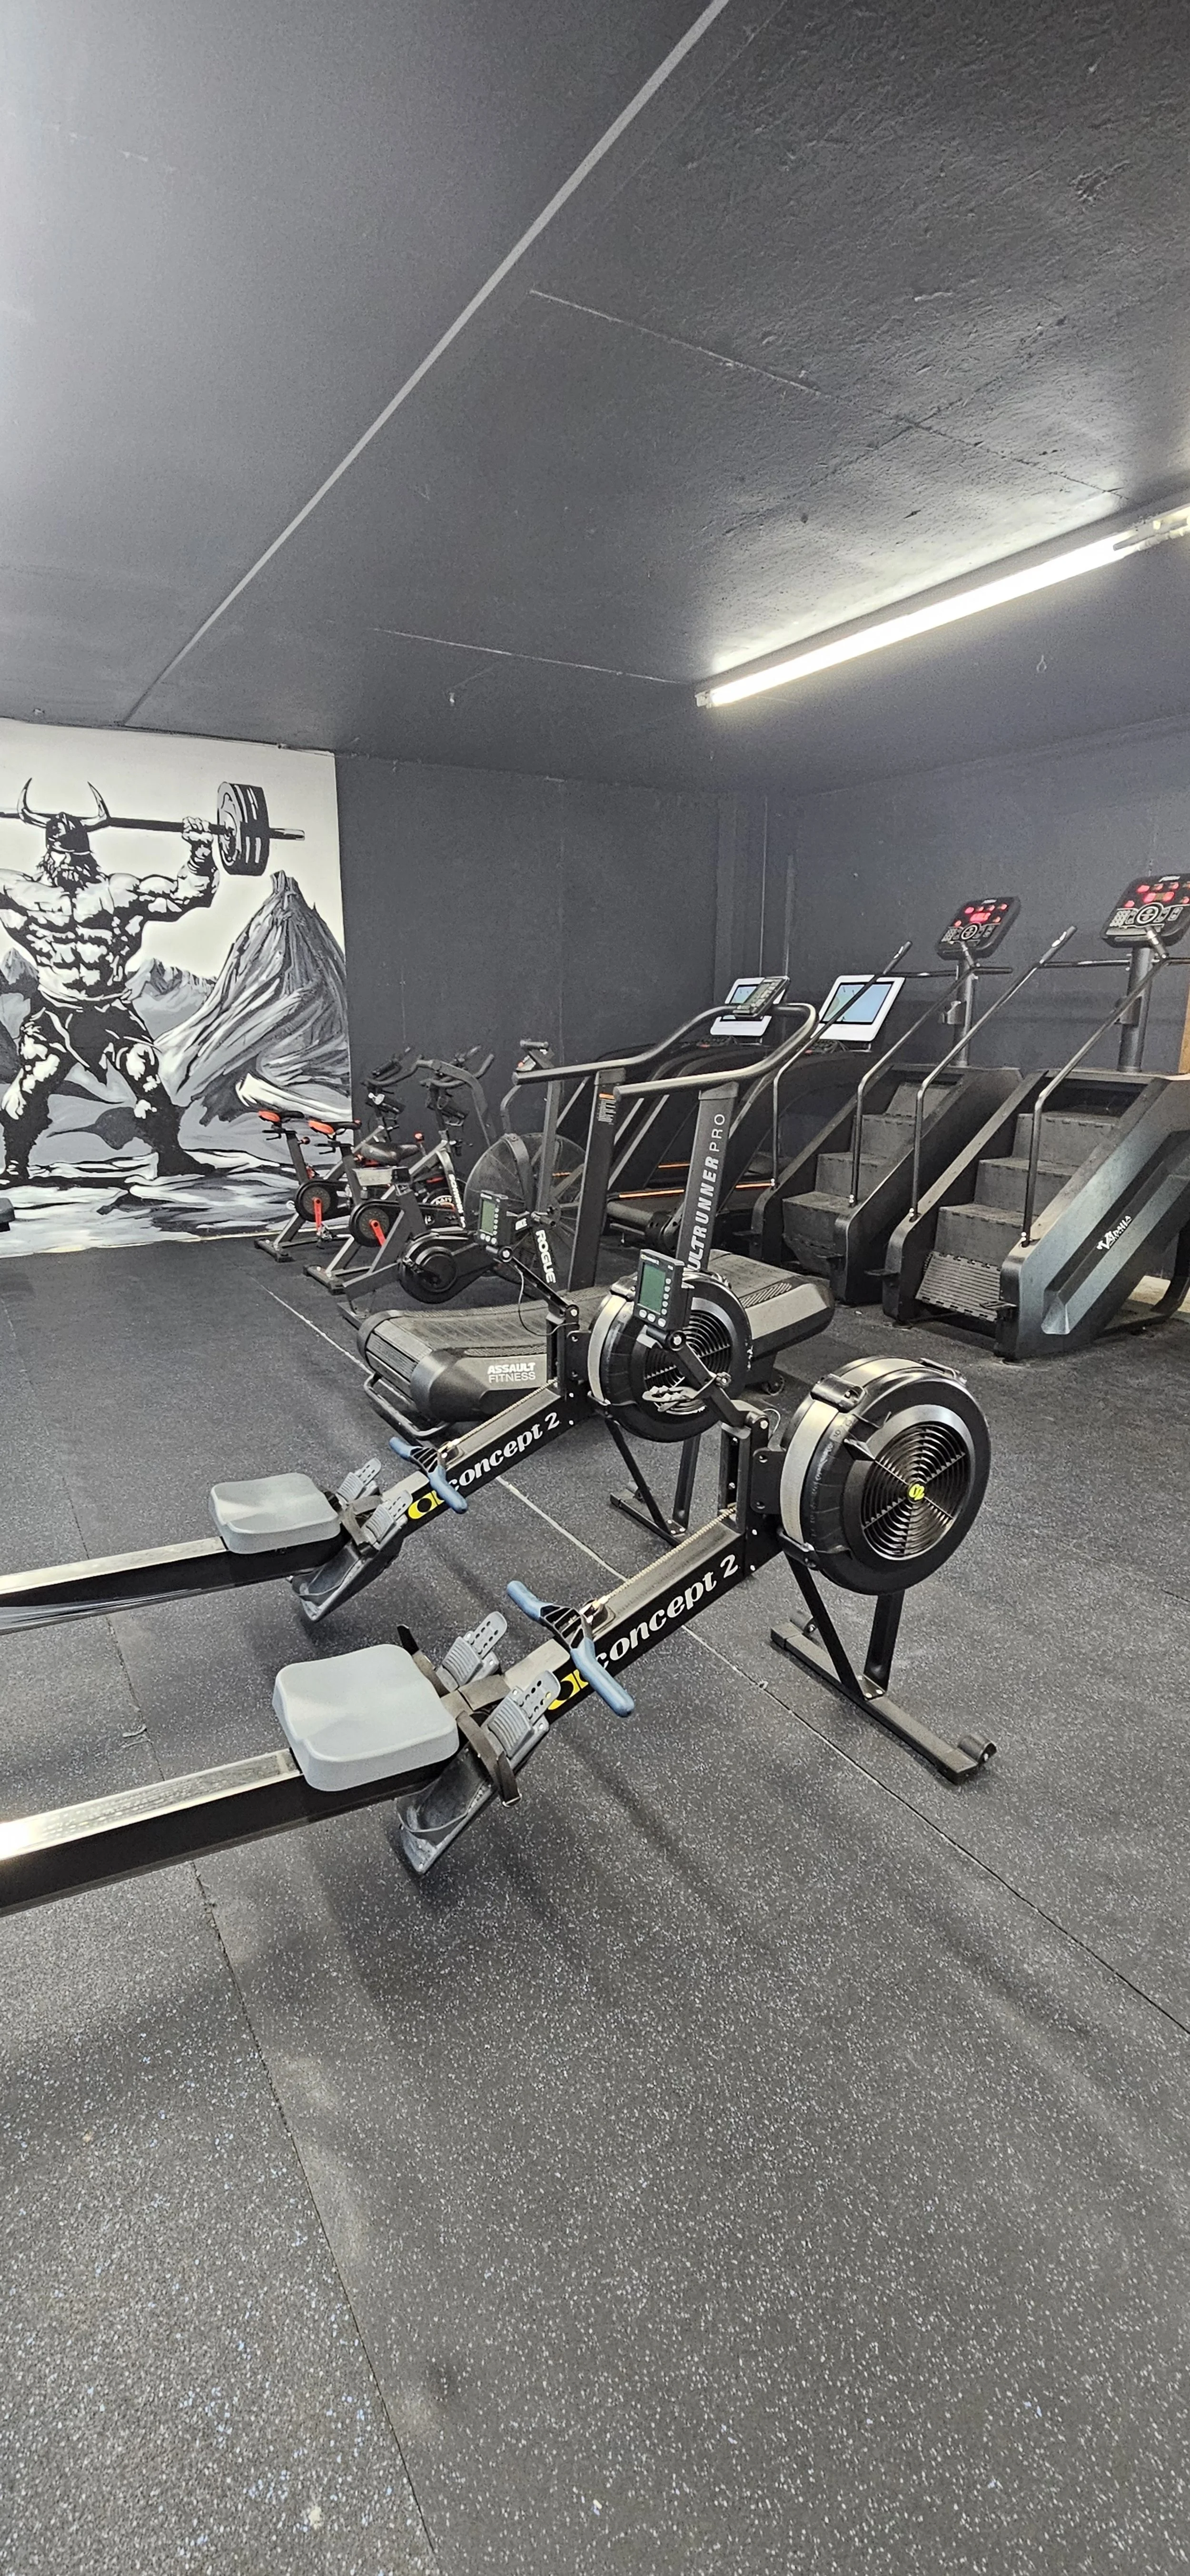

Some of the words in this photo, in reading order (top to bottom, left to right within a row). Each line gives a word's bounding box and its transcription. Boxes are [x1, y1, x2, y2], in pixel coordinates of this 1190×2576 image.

[687, 1155, 719, 1271] ULTRUNNER
[709, 1114, 725, 1152] PRO
[536, 1230, 556, 1283] ROGUE
[487, 1362, 536, 1374] ASSAULT
[488, 1372, 536, 1383] FITNESS
[545, 1412, 560, 1430] 2
[720, 1554, 738, 1578] 2
